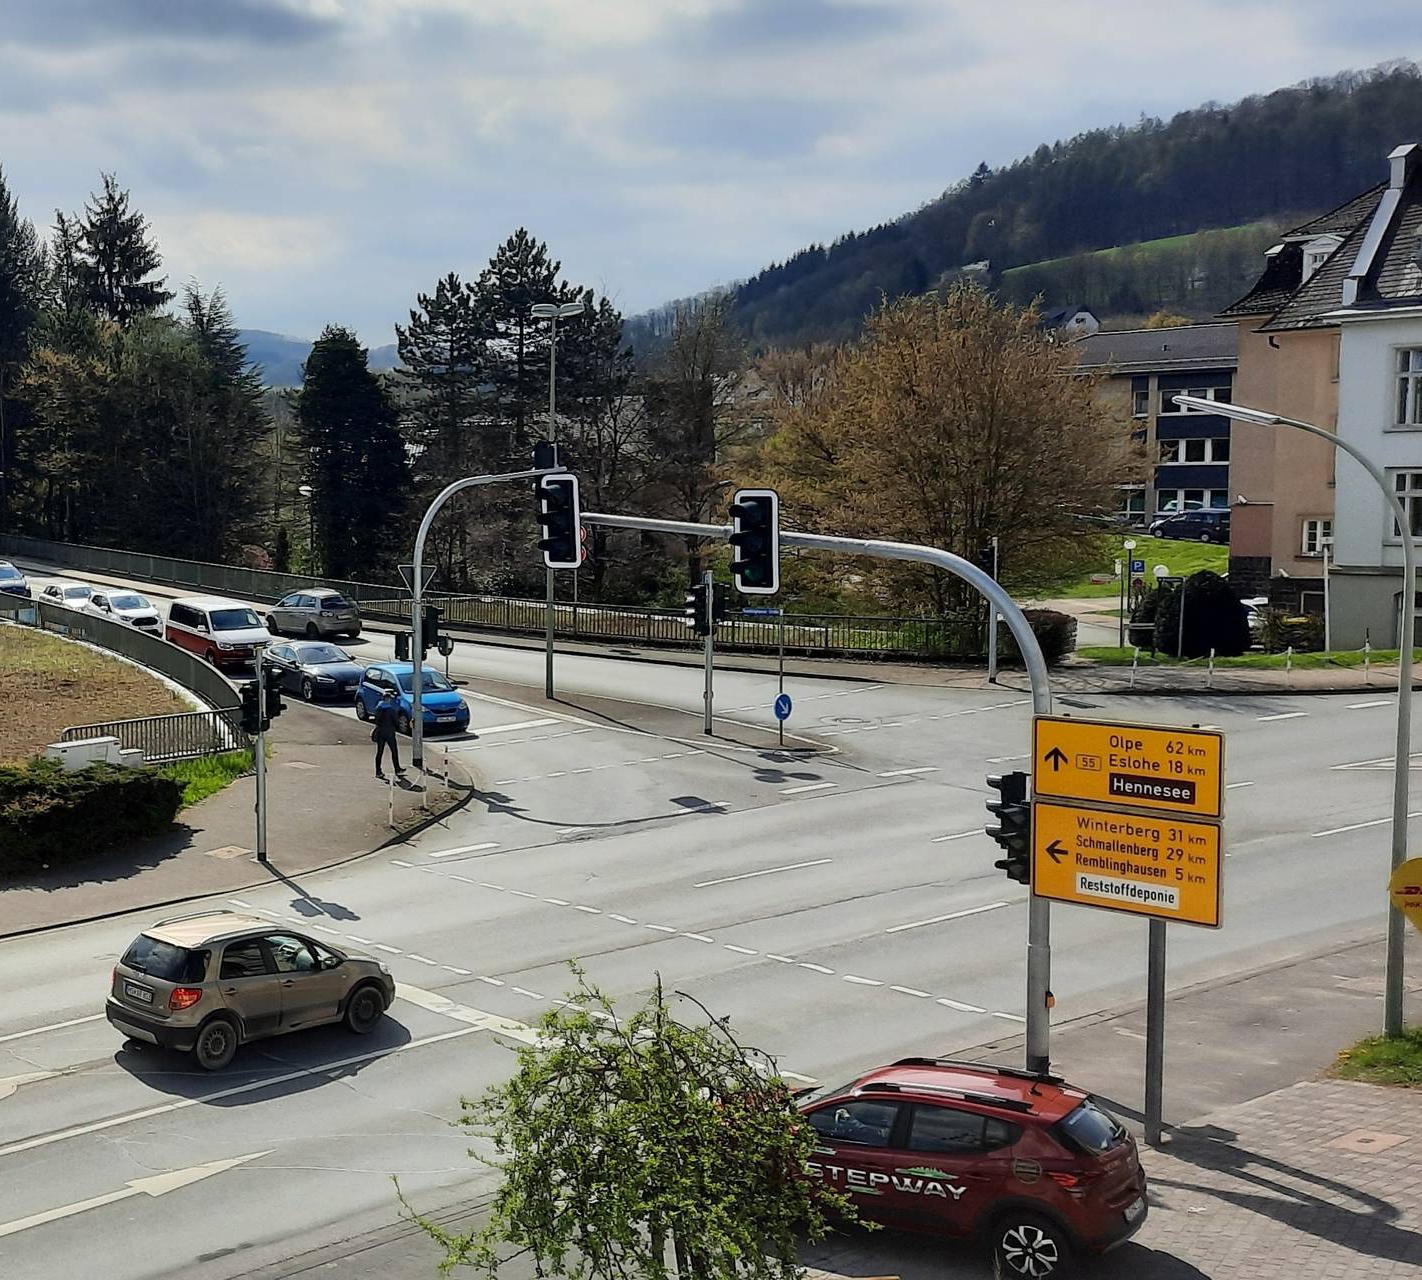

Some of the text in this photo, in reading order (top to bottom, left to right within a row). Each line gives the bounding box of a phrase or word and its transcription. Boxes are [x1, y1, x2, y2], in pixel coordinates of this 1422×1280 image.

[1109, 735, 1206, 757] Olpe 62 km
[1082, 758, 1095, 768] 55
[1109, 754, 1206, 776] Eslohe 18 km
[1113, 778, 1191, 799] Hennesee
[1077, 816, 1207, 846] Winterberg 31 km
[1076, 835, 1206, 865] Schmallenberg 29 km
[1075, 853, 1206, 884] Remblinghausen 5 km
[1080, 877, 1175, 904] Reststoffdeponie
[806, 1162, 968, 1200] STEPWAY
